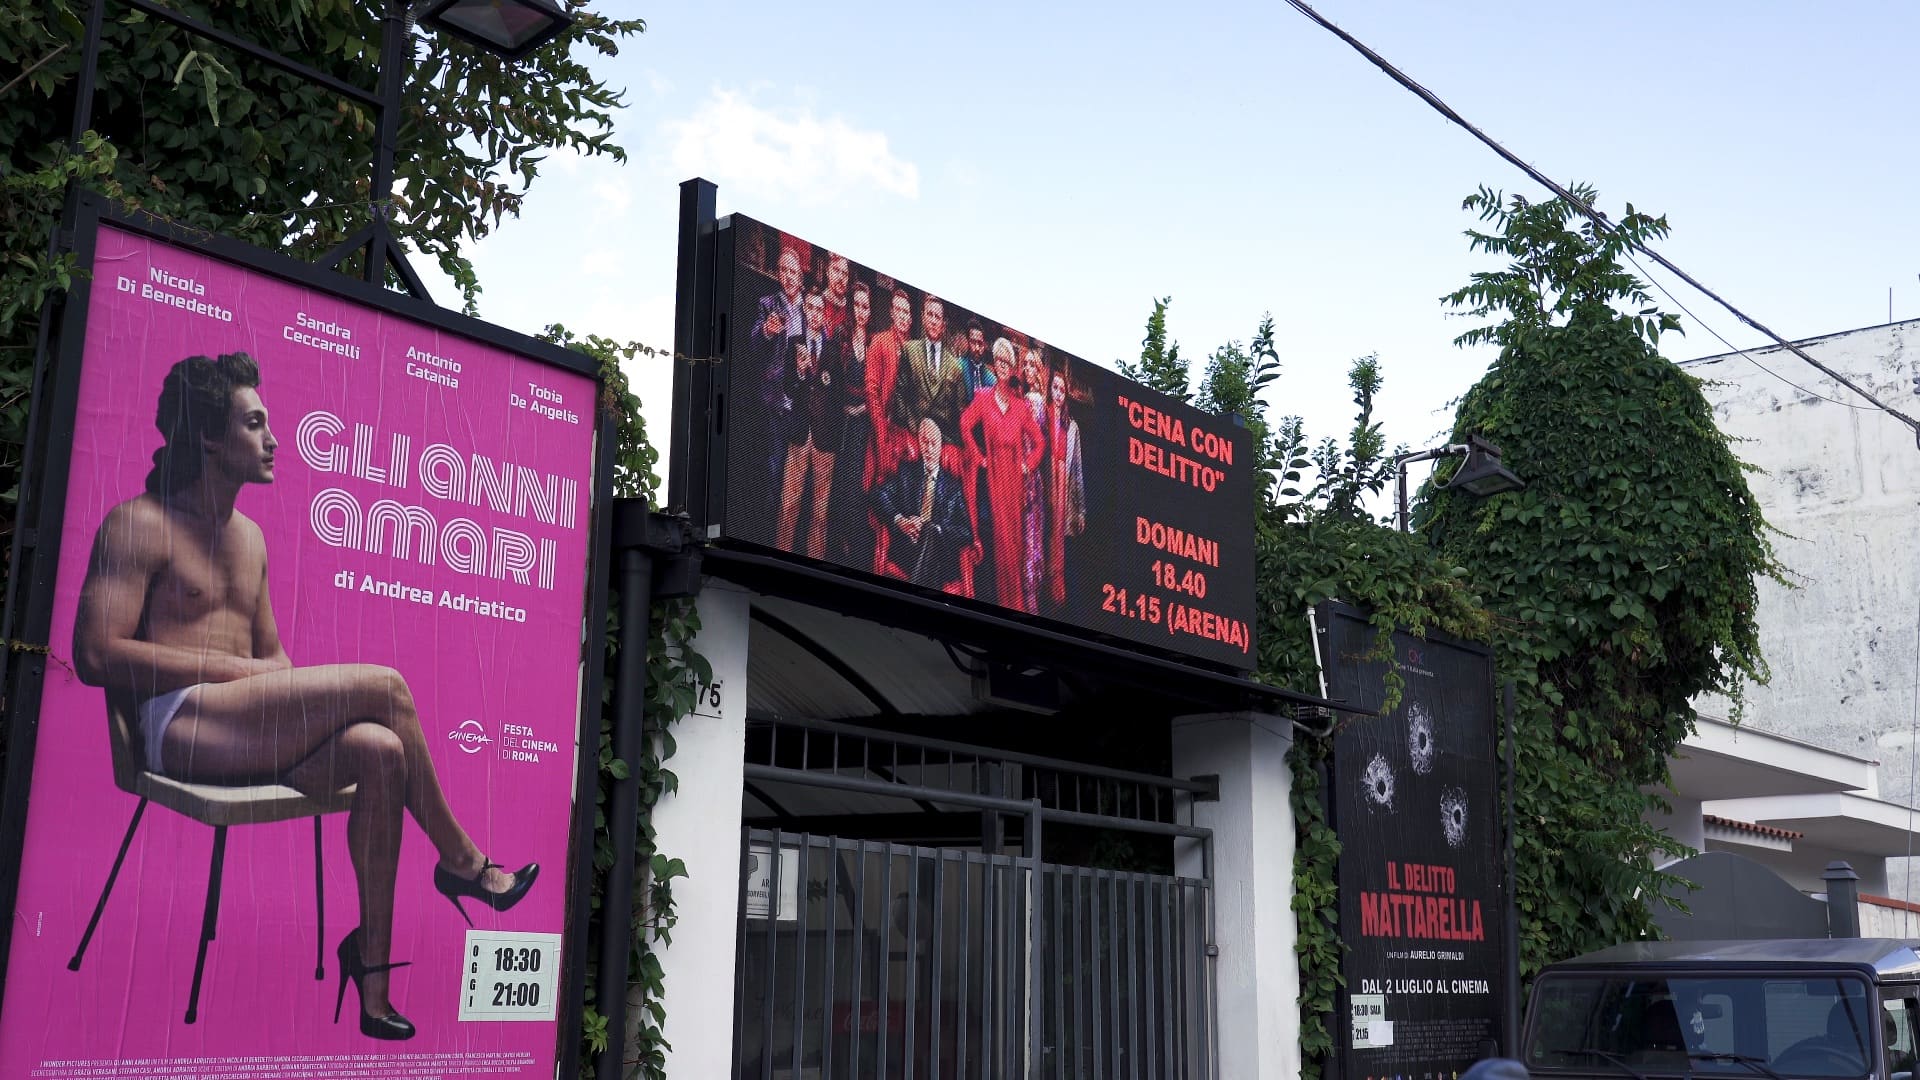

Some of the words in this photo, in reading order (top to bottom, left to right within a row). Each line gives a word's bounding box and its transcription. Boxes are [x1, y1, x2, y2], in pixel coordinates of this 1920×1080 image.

[150, 267, 205, 296] Nicola
[117, 276, 136, 294] Di
[142, 283, 232, 322] Benedetto
[296, 312, 351, 340] Sandra
[283, 326, 360, 360] Ceccarelli
[406, 346, 462, 373] Antonio
[406, 363, 459, 389] Catania
[511, 393, 526, 409] De
[530, 400, 579, 424] Angelis
[528, 383, 563, 405] Tobia
[1118, 395, 1186, 447] "CENA
[1190, 427, 1233, 465] CON
[296, 410, 411, 489] GLI
[1129, 437, 1224, 493] DELITTO"
[1136, 517, 1219, 568] DOMANI
[1151, 560, 1207, 599] 18.40
[334, 570, 355, 590] di
[360, 574, 434, 605] Andrea
[438, 590, 526, 623] Adriatico
[1102, 583, 1161, 624] 21.15
[1167, 603, 1249, 654] (ARENA)
[448, 730, 493, 745] CINEMA
[503, 723, 533, 737] FESTA
[503, 736, 520, 748] DEL
[522, 739, 558, 753] CINEMA
[503, 749, 511, 759] DI
[512, 751, 539, 763] ROMA
[1387, 861, 1401, 890] IL
[1404, 863, 1455, 894] DELITTO
[1360, 891, 1484, 941] MATTARELLA
[494, 947, 541, 972] 18:30
[1410, 950, 1436, 960] AURELIO
[492, 982, 540, 1007] 21:00
[1362, 979, 1383, 994] DAL
[1386, 979, 1392, 994] 2
[1396, 979, 1434, 994] LUGLIO
[1436, 979, 1449, 994] AL
[1451, 980, 1489, 994] CINEMA
